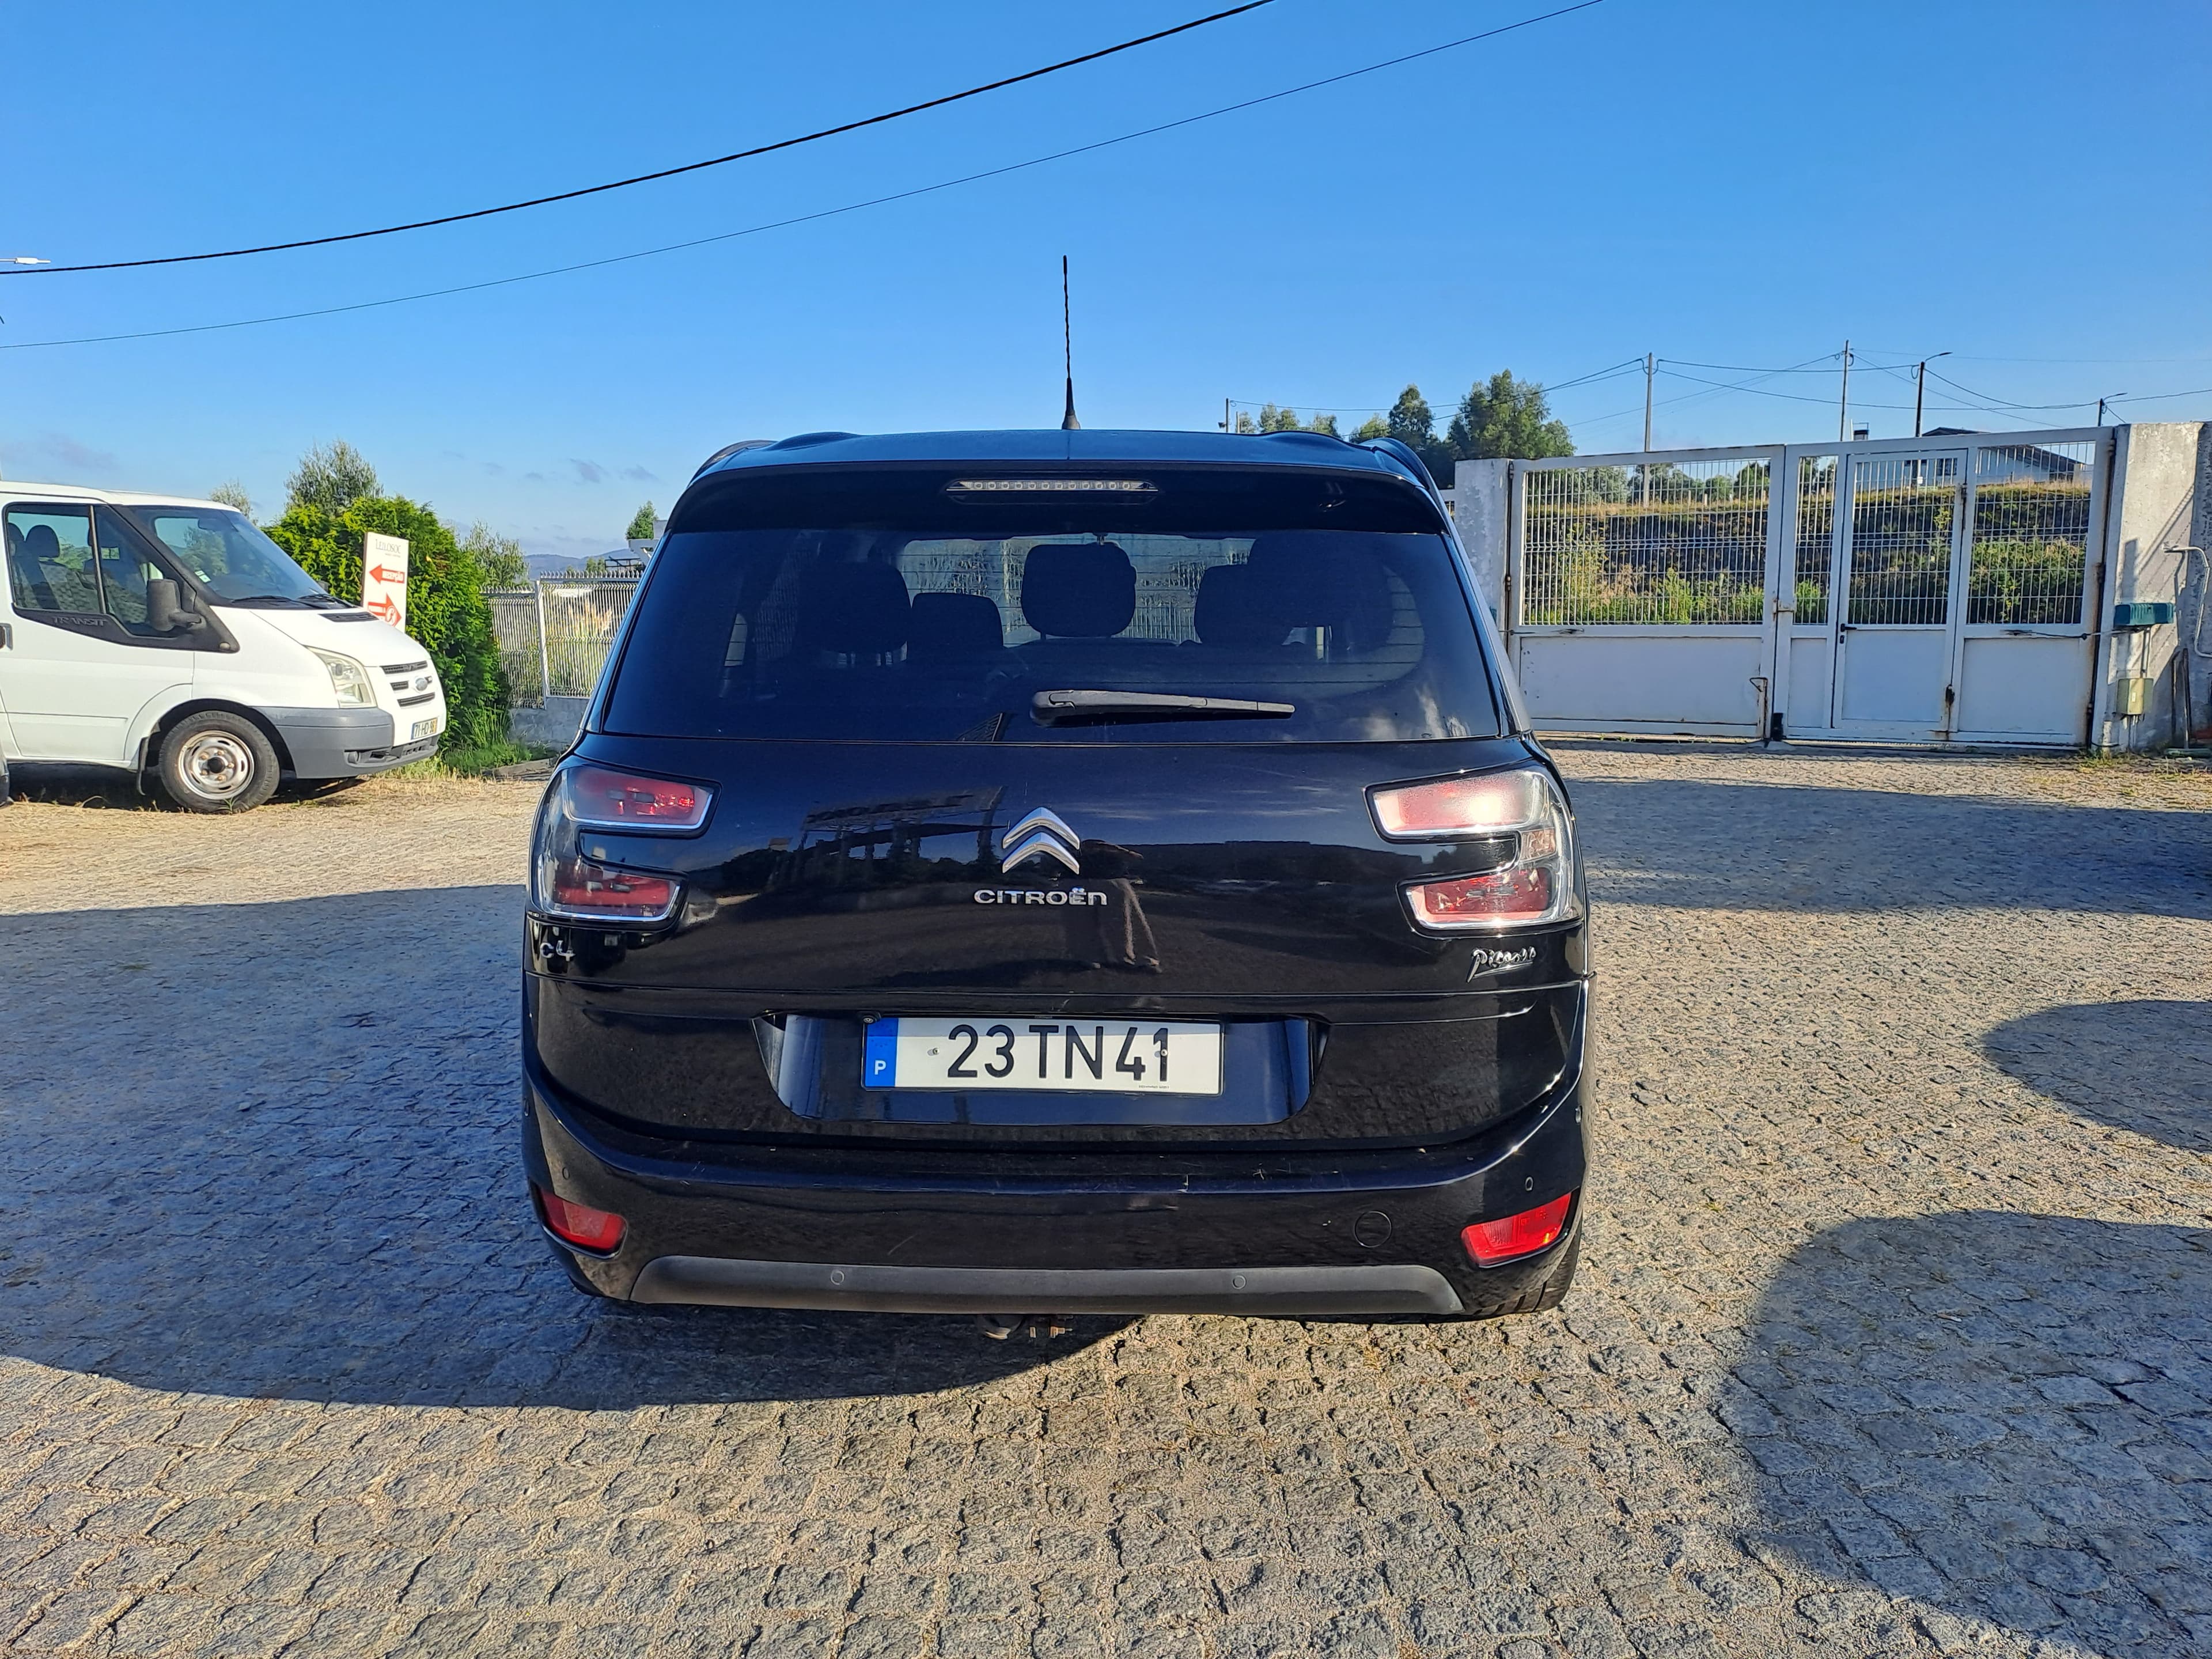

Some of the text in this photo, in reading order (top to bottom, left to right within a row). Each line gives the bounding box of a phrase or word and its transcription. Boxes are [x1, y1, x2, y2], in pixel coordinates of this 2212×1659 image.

[52, 616, 108, 627] TRANSIT
[540, 940, 576, 962] C4
[1467, 946, 1536, 982] Picasso
[874, 1060, 887, 1075] P
